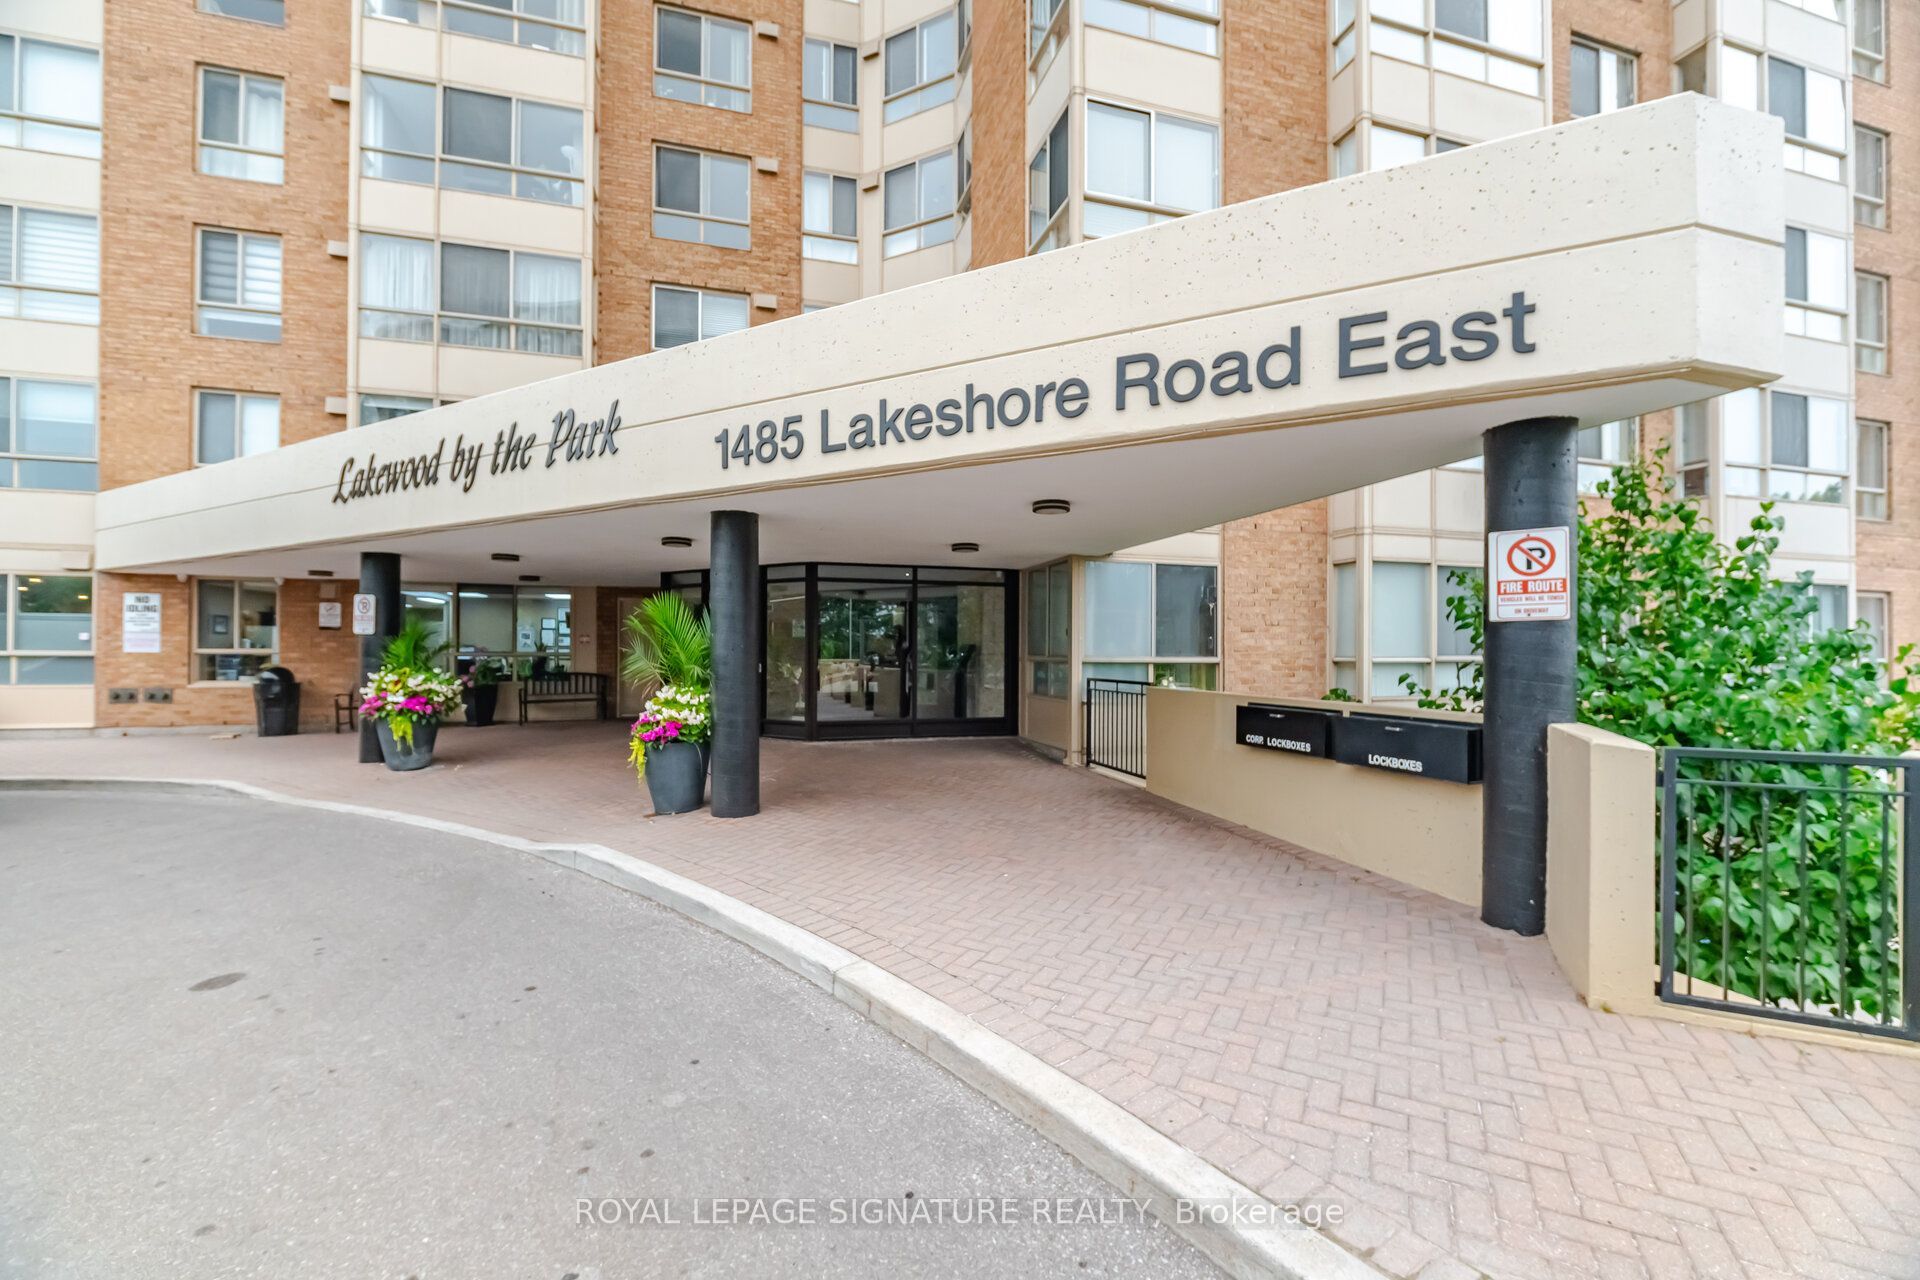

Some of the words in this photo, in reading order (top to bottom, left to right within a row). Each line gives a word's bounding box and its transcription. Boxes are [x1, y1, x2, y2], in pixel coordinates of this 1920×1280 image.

[714, 415, 804, 469] 1485
[820, 377, 1090, 454] Lakeshore
[1115, 325, 1301, 410] Road
[1338, 291, 1537, 379] East
[332, 437, 445, 504] Lakewood
[450, 433, 483, 493] by
[490, 421, 536, 475] the
[545, 399, 622, 469] Park
[1500, 581, 1523, 593] FIRE
[1527, 579, 1564, 592] ROUTE
[1267, 736, 1311, 753] LOCKBOXES
[1368, 753, 1423, 773] LOCKBOXES
